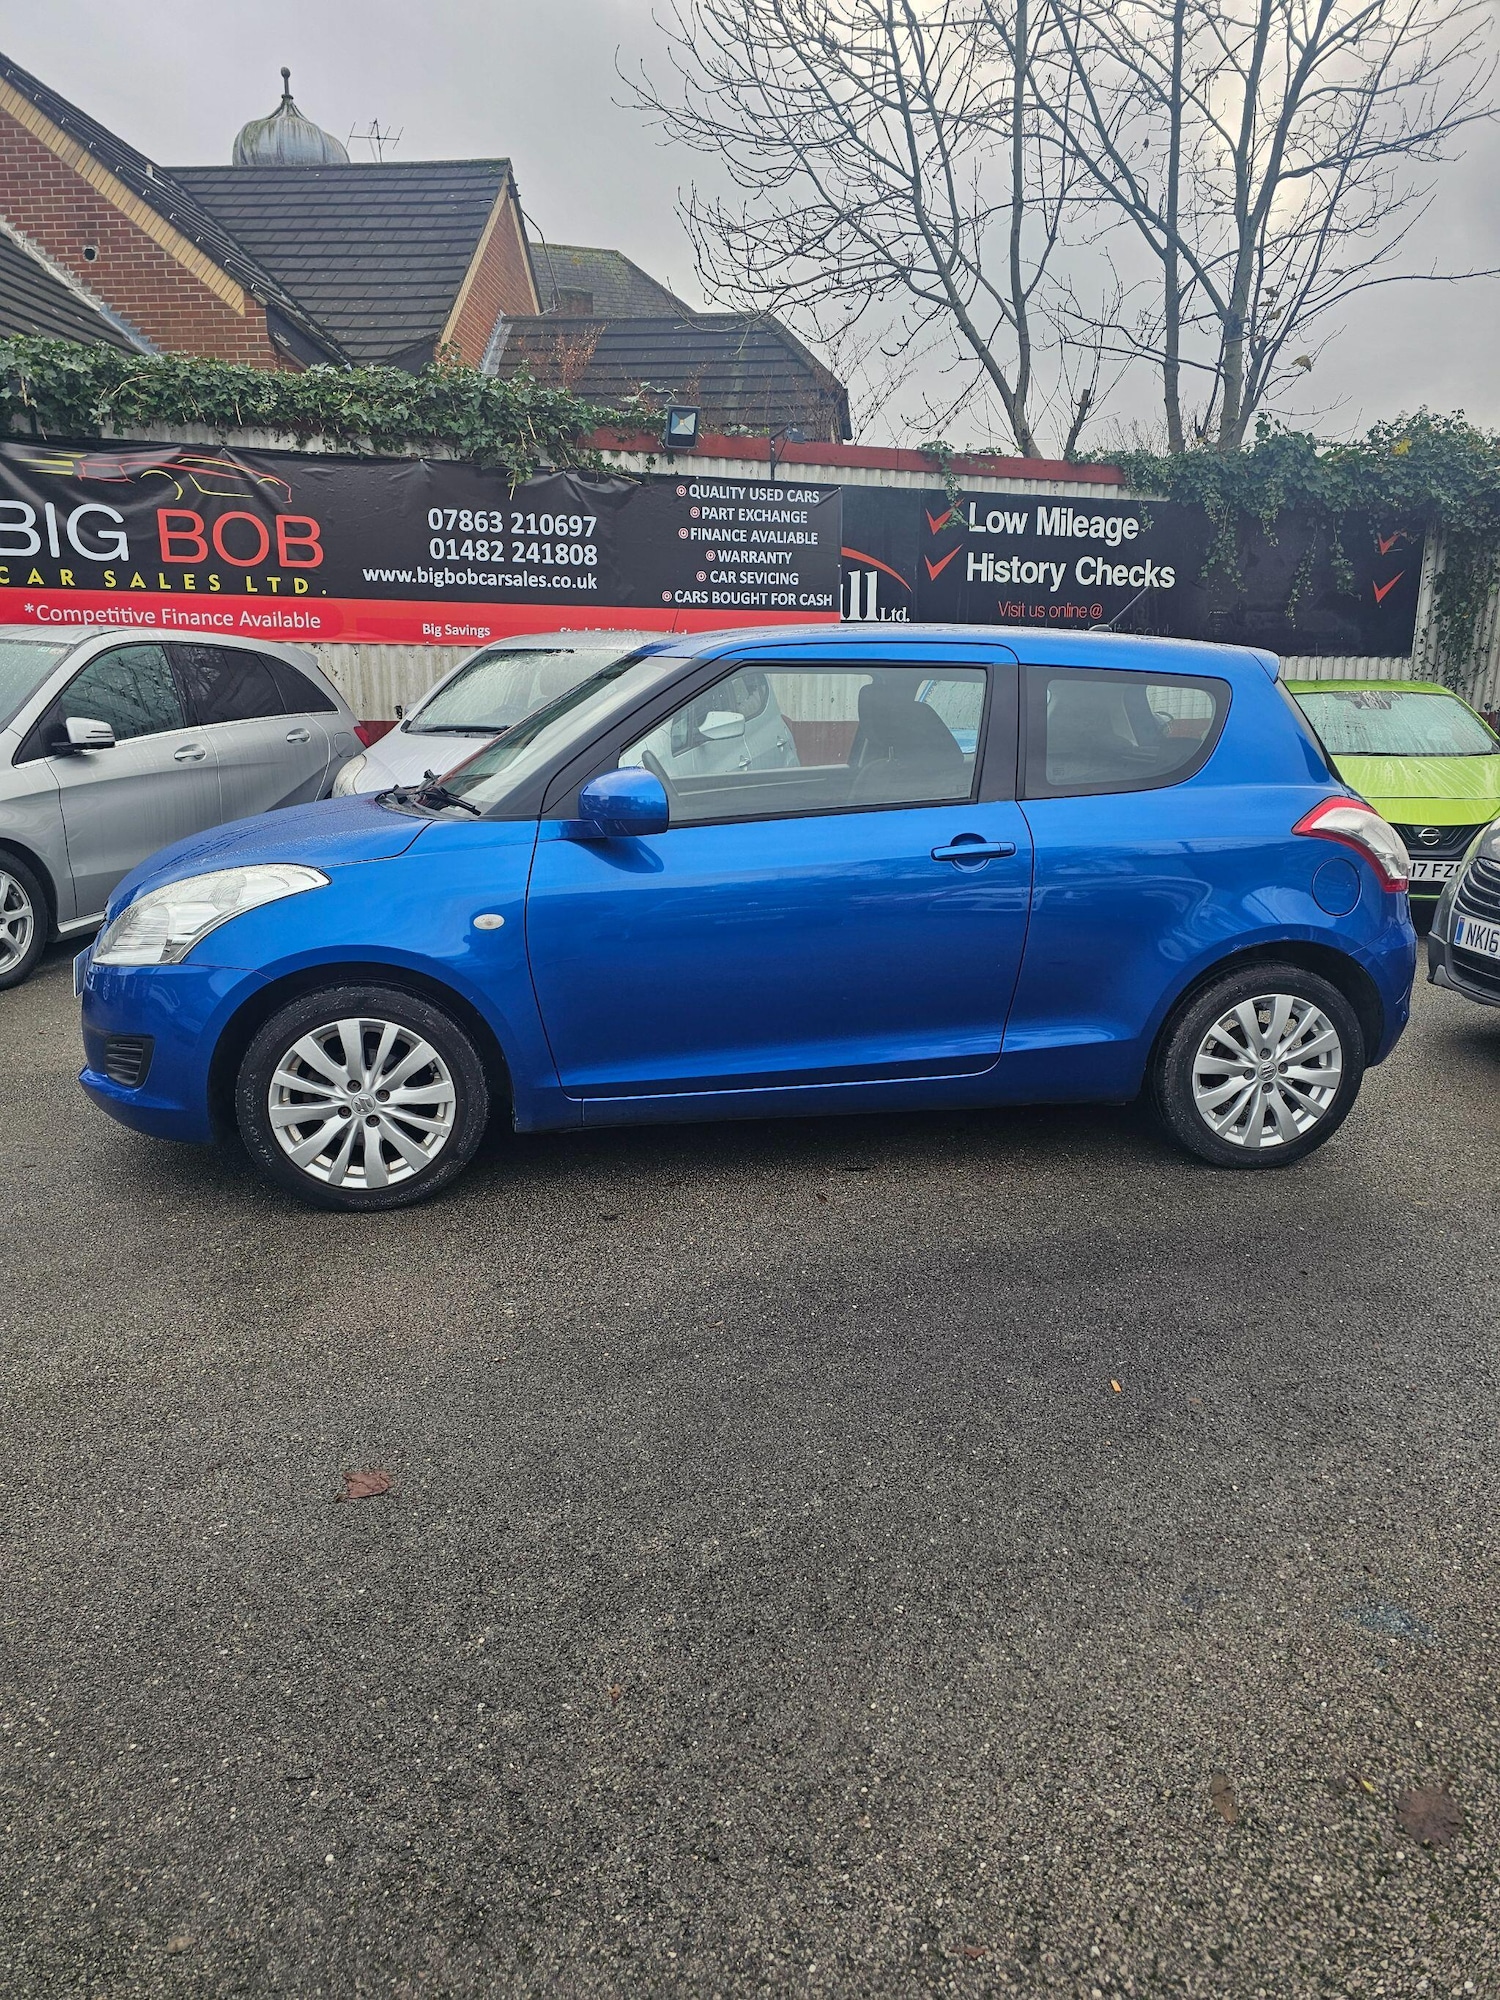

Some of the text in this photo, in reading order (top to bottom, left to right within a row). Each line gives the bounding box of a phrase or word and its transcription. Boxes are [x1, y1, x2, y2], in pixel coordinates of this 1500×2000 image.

[688, 484, 820, 504] QUALITY USED CARS
[428, 507, 597, 537] 07863 210697
[701, 506, 808, 524] PART EXCHANGE
[968, 502, 1139, 547] Low Mileage
[0, 500, 324, 569] BIG BOB
[690, 528, 819, 545] FINANCE AVALIABLE
[429, 537, 598, 566] 01482 241808
[717, 549, 793, 565] WARRANTY
[0, 566, 328, 595] CAR SALES LTD.
[362, 566, 598, 590] www.bigbobcarsales.co.uk
[709, 570, 799, 586] CAR SEVICING
[966, 552, 1176, 593] History Checks
[674, 590, 833, 607] CARS BOUGHT FOR CASH
[162, 608, 234, 628] Finance
[239, 611, 321, 629] Available
[880, 606, 911, 623] Ltd.
[998, 601, 1025, 618] Visit
[1029, 603, 1045, 618] us
[1049, 603, 1087, 619] online
[422, 623, 491, 637] Big Savings
